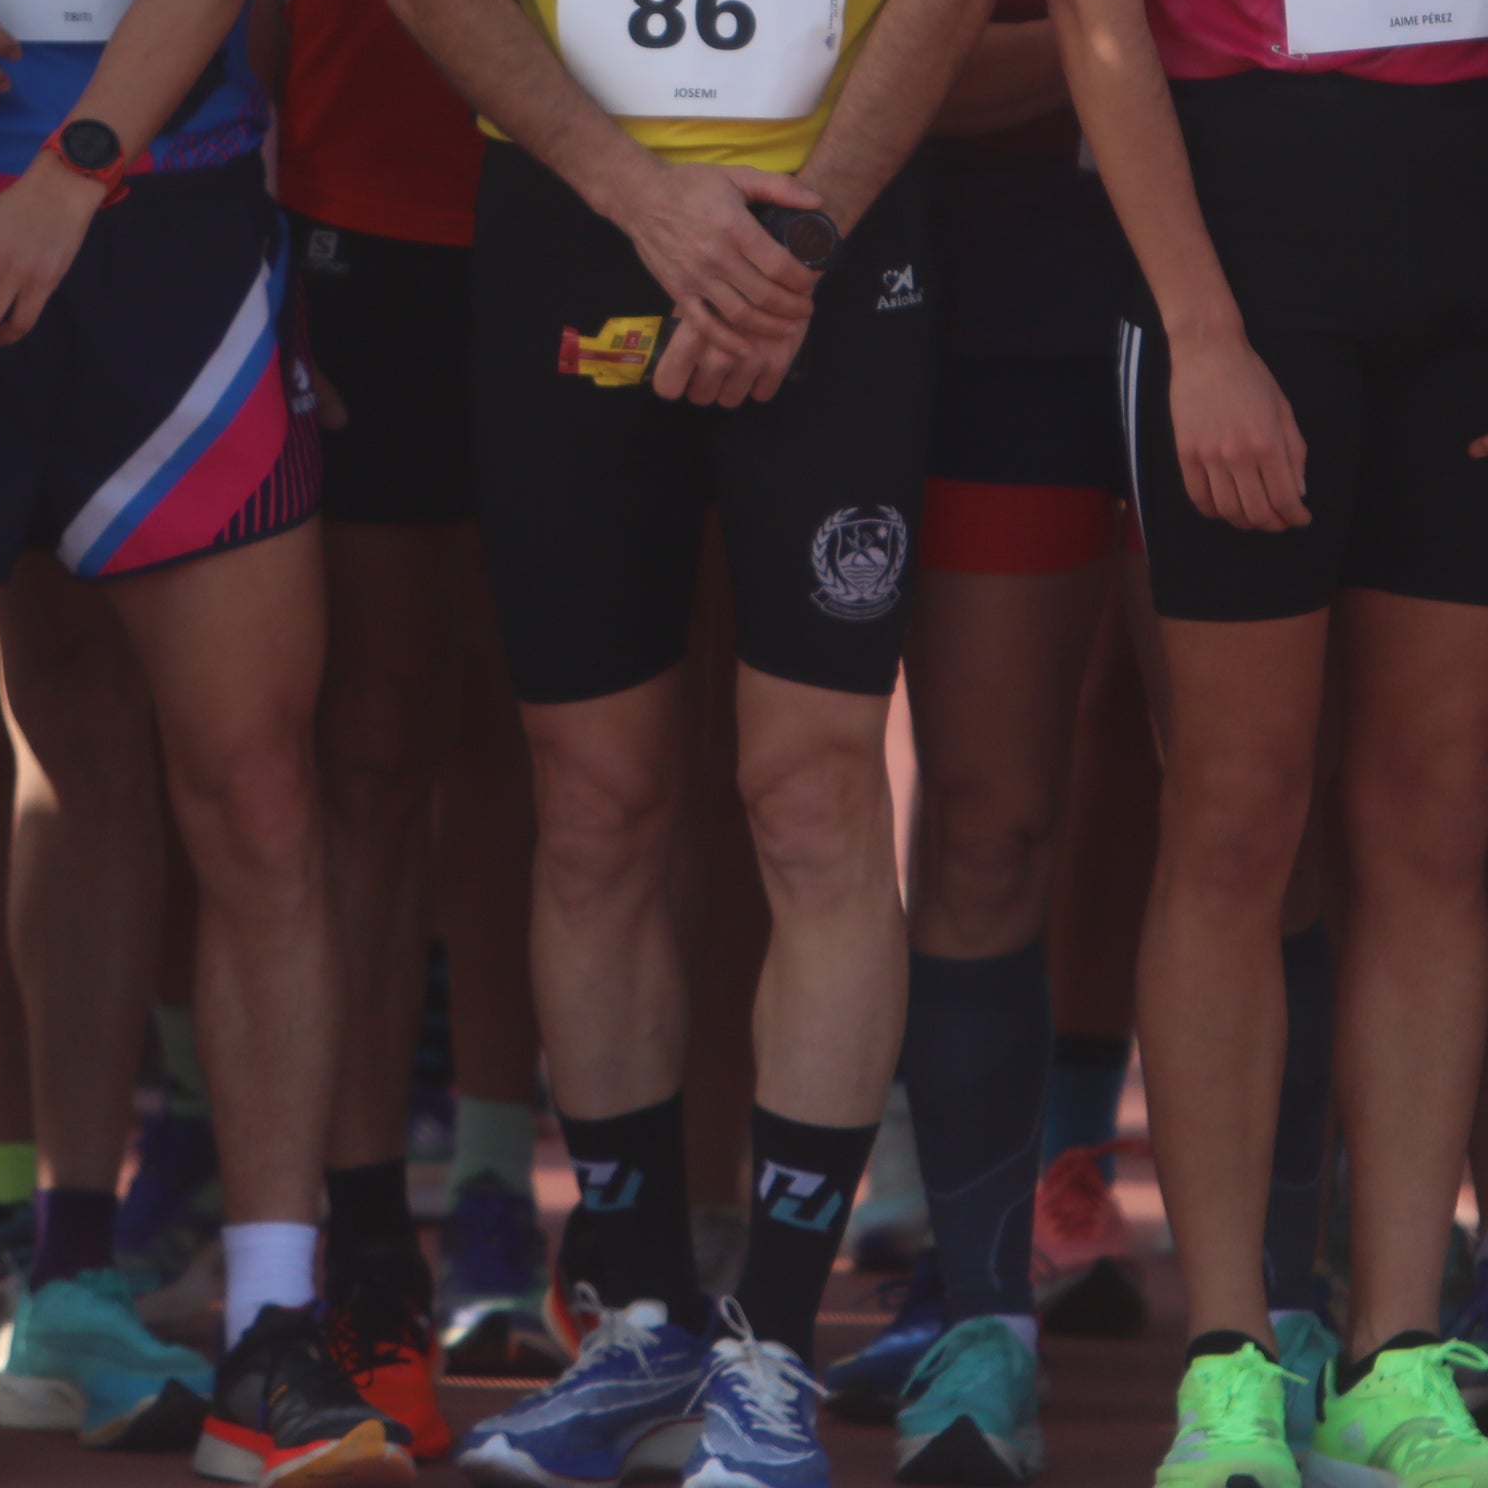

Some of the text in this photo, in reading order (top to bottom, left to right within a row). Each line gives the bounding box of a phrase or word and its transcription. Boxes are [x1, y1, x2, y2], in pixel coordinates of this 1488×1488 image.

[1390, 12, 1453, 28] JAIME PÉREZ
[673, 87, 718, 100] JOSEMI
